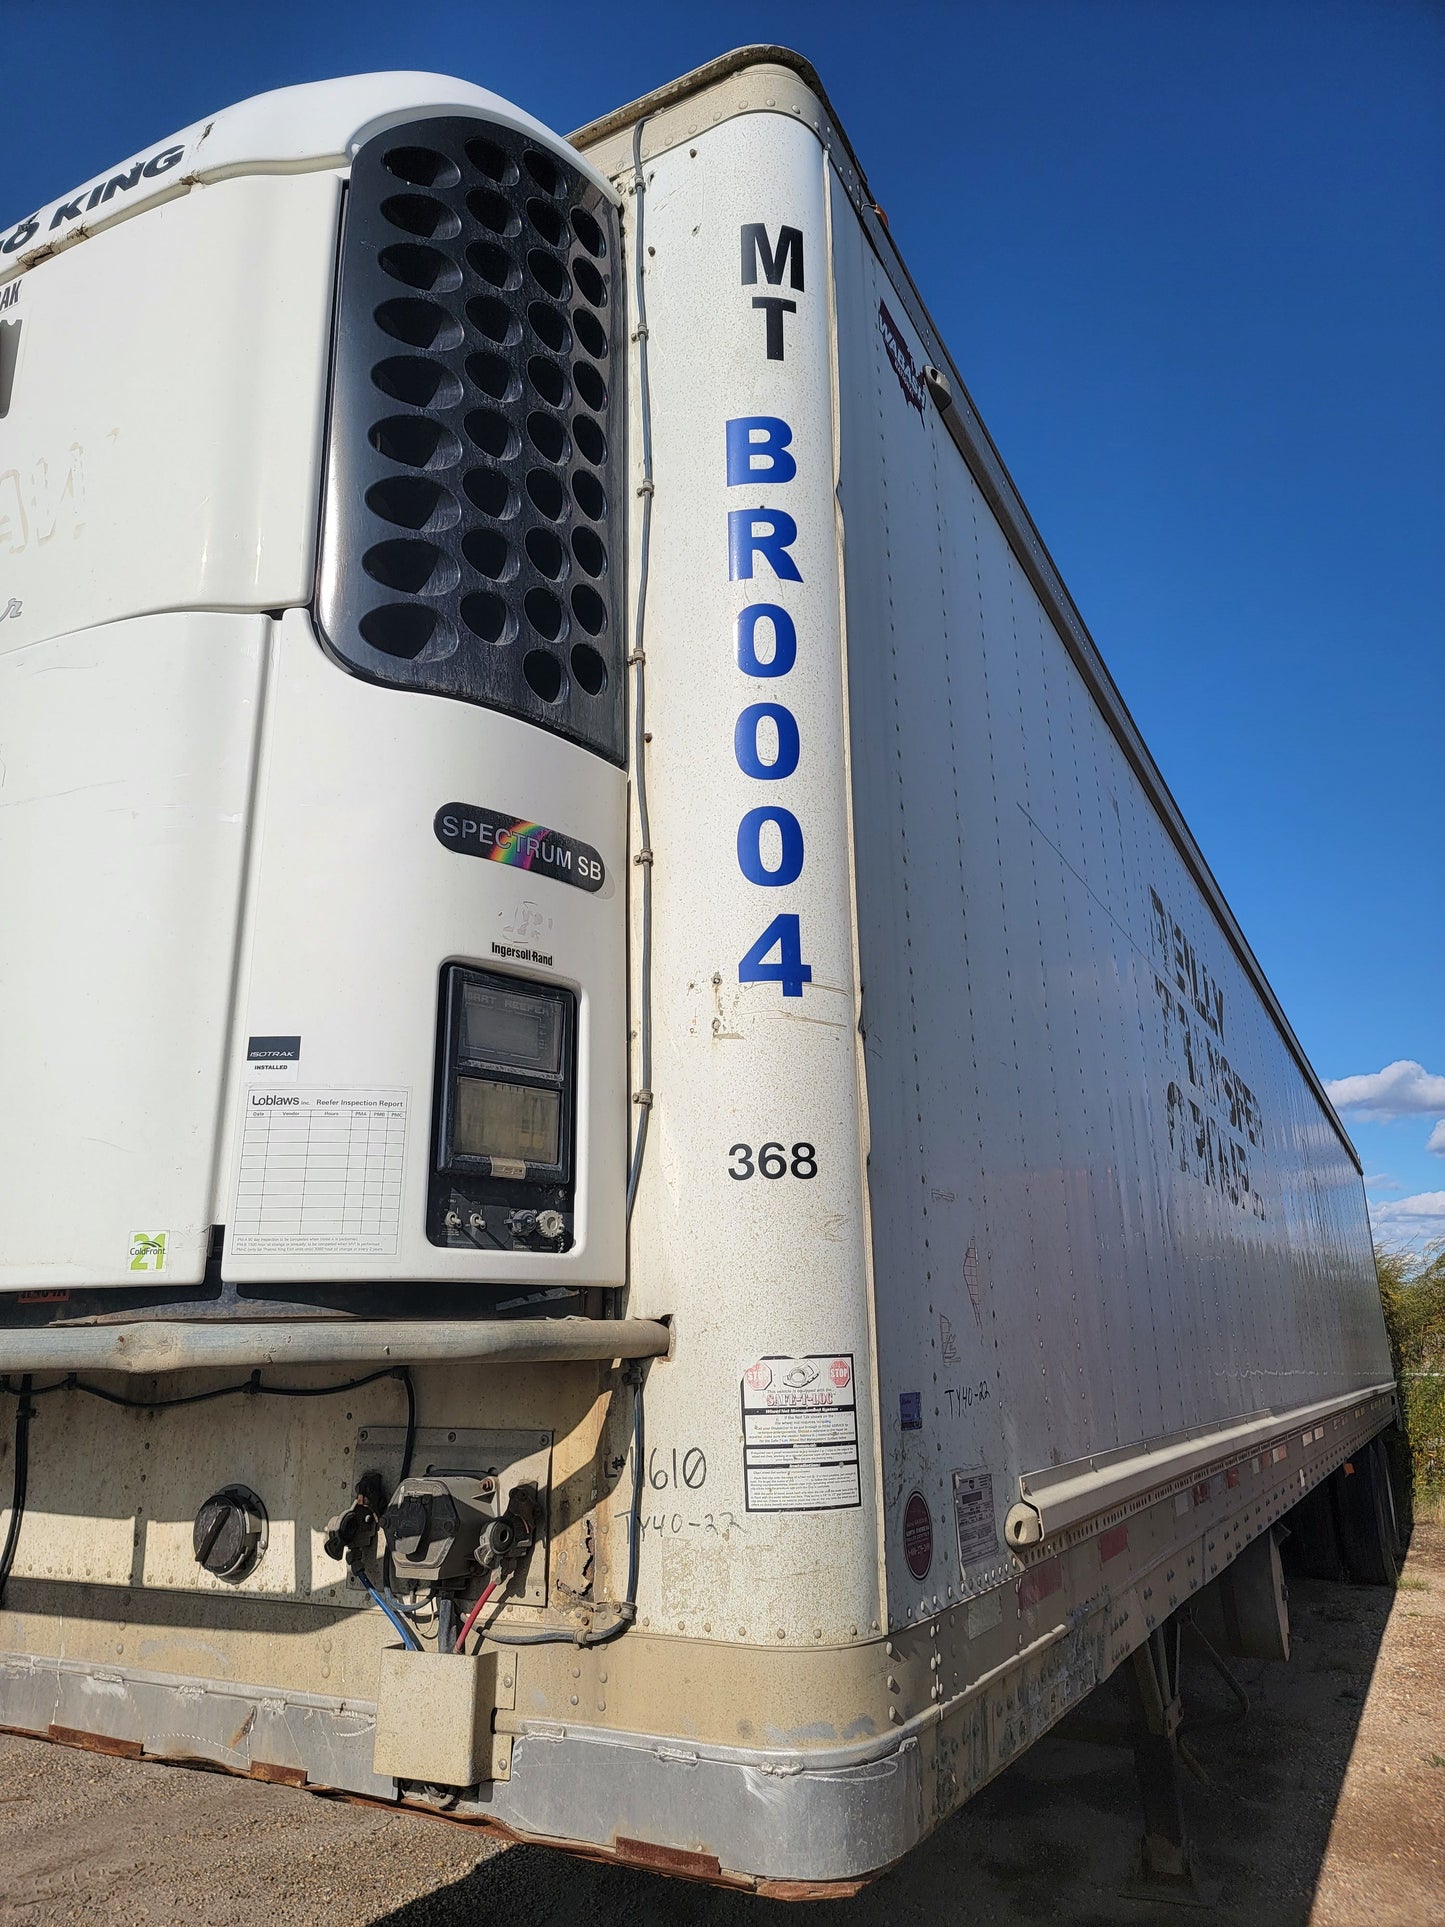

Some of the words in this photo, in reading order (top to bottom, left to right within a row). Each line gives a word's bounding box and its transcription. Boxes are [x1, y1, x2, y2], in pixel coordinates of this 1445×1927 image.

[49, 145, 186, 231] KING
[0, 279, 23, 311] AK
[879, 312, 927, 411] WABASH
[442, 815, 572, 870] SPECTRUM
[577, 855, 602, 881] SB
[249, 1050, 295, 1058] ISOTRAK
[252, 1094, 300, 1106] Loblaws
[316, 1098, 339, 1107] Reefer
[340, 1098, 378, 1108] Inspection
[379, 1098, 403, 1108] Report
[729, 1142, 818, 1181] 368
[129, 1247, 167, 1256] ColdFront
[131, 1233, 166, 1271] 21
[830, 1367, 848, 1378] STOP
[766, 1392, 834, 1407] SAFE-T-LOC
